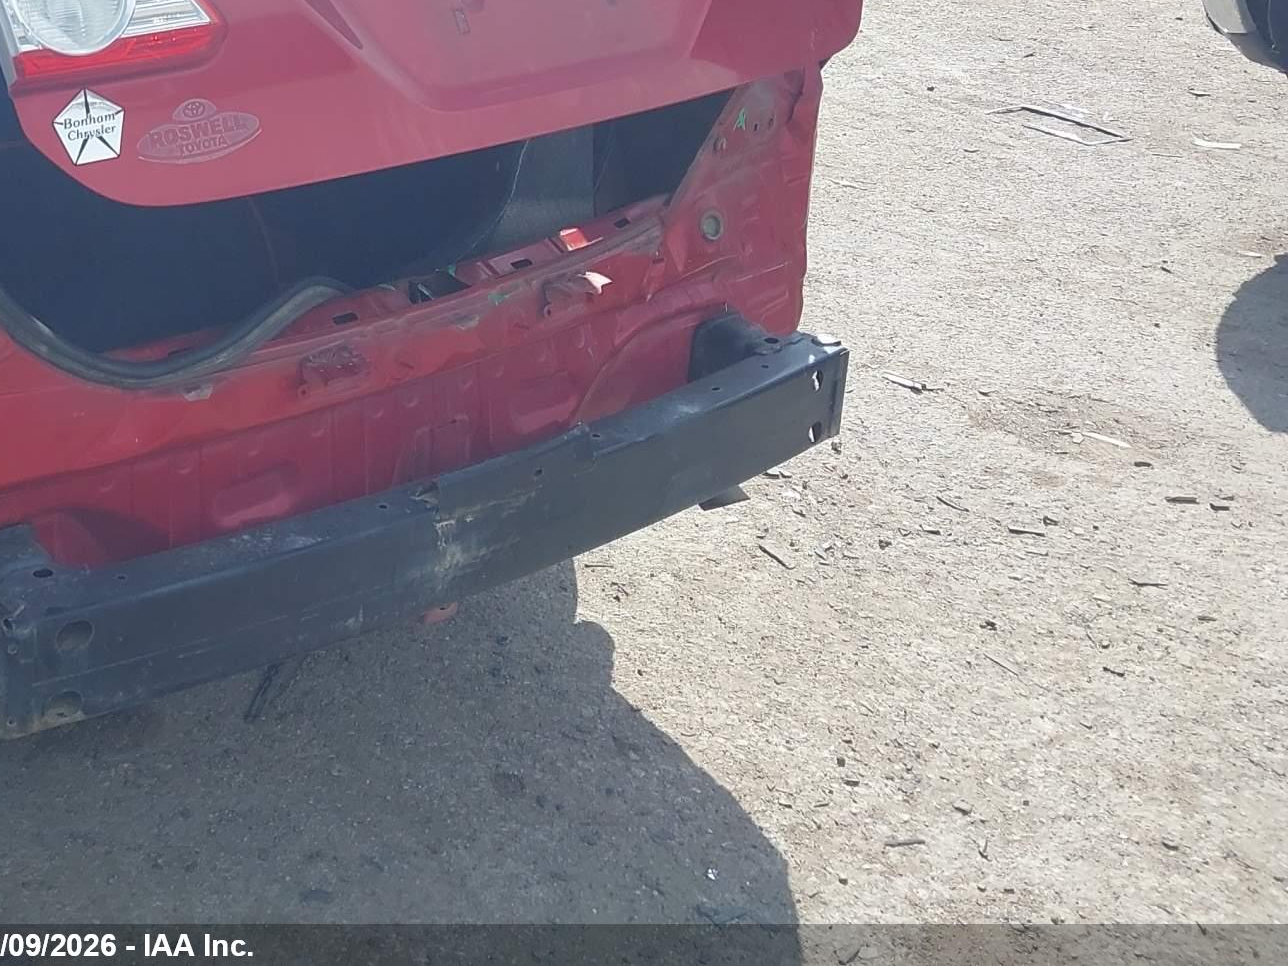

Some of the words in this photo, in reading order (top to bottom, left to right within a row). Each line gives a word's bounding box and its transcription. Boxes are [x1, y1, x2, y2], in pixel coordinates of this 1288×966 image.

[63, 112, 115, 130] Bonham
[67, 124, 116, 141] Chrysler
[150, 116, 247, 149] ROSWELL
[174, 135, 229, 155] TOYOTA
